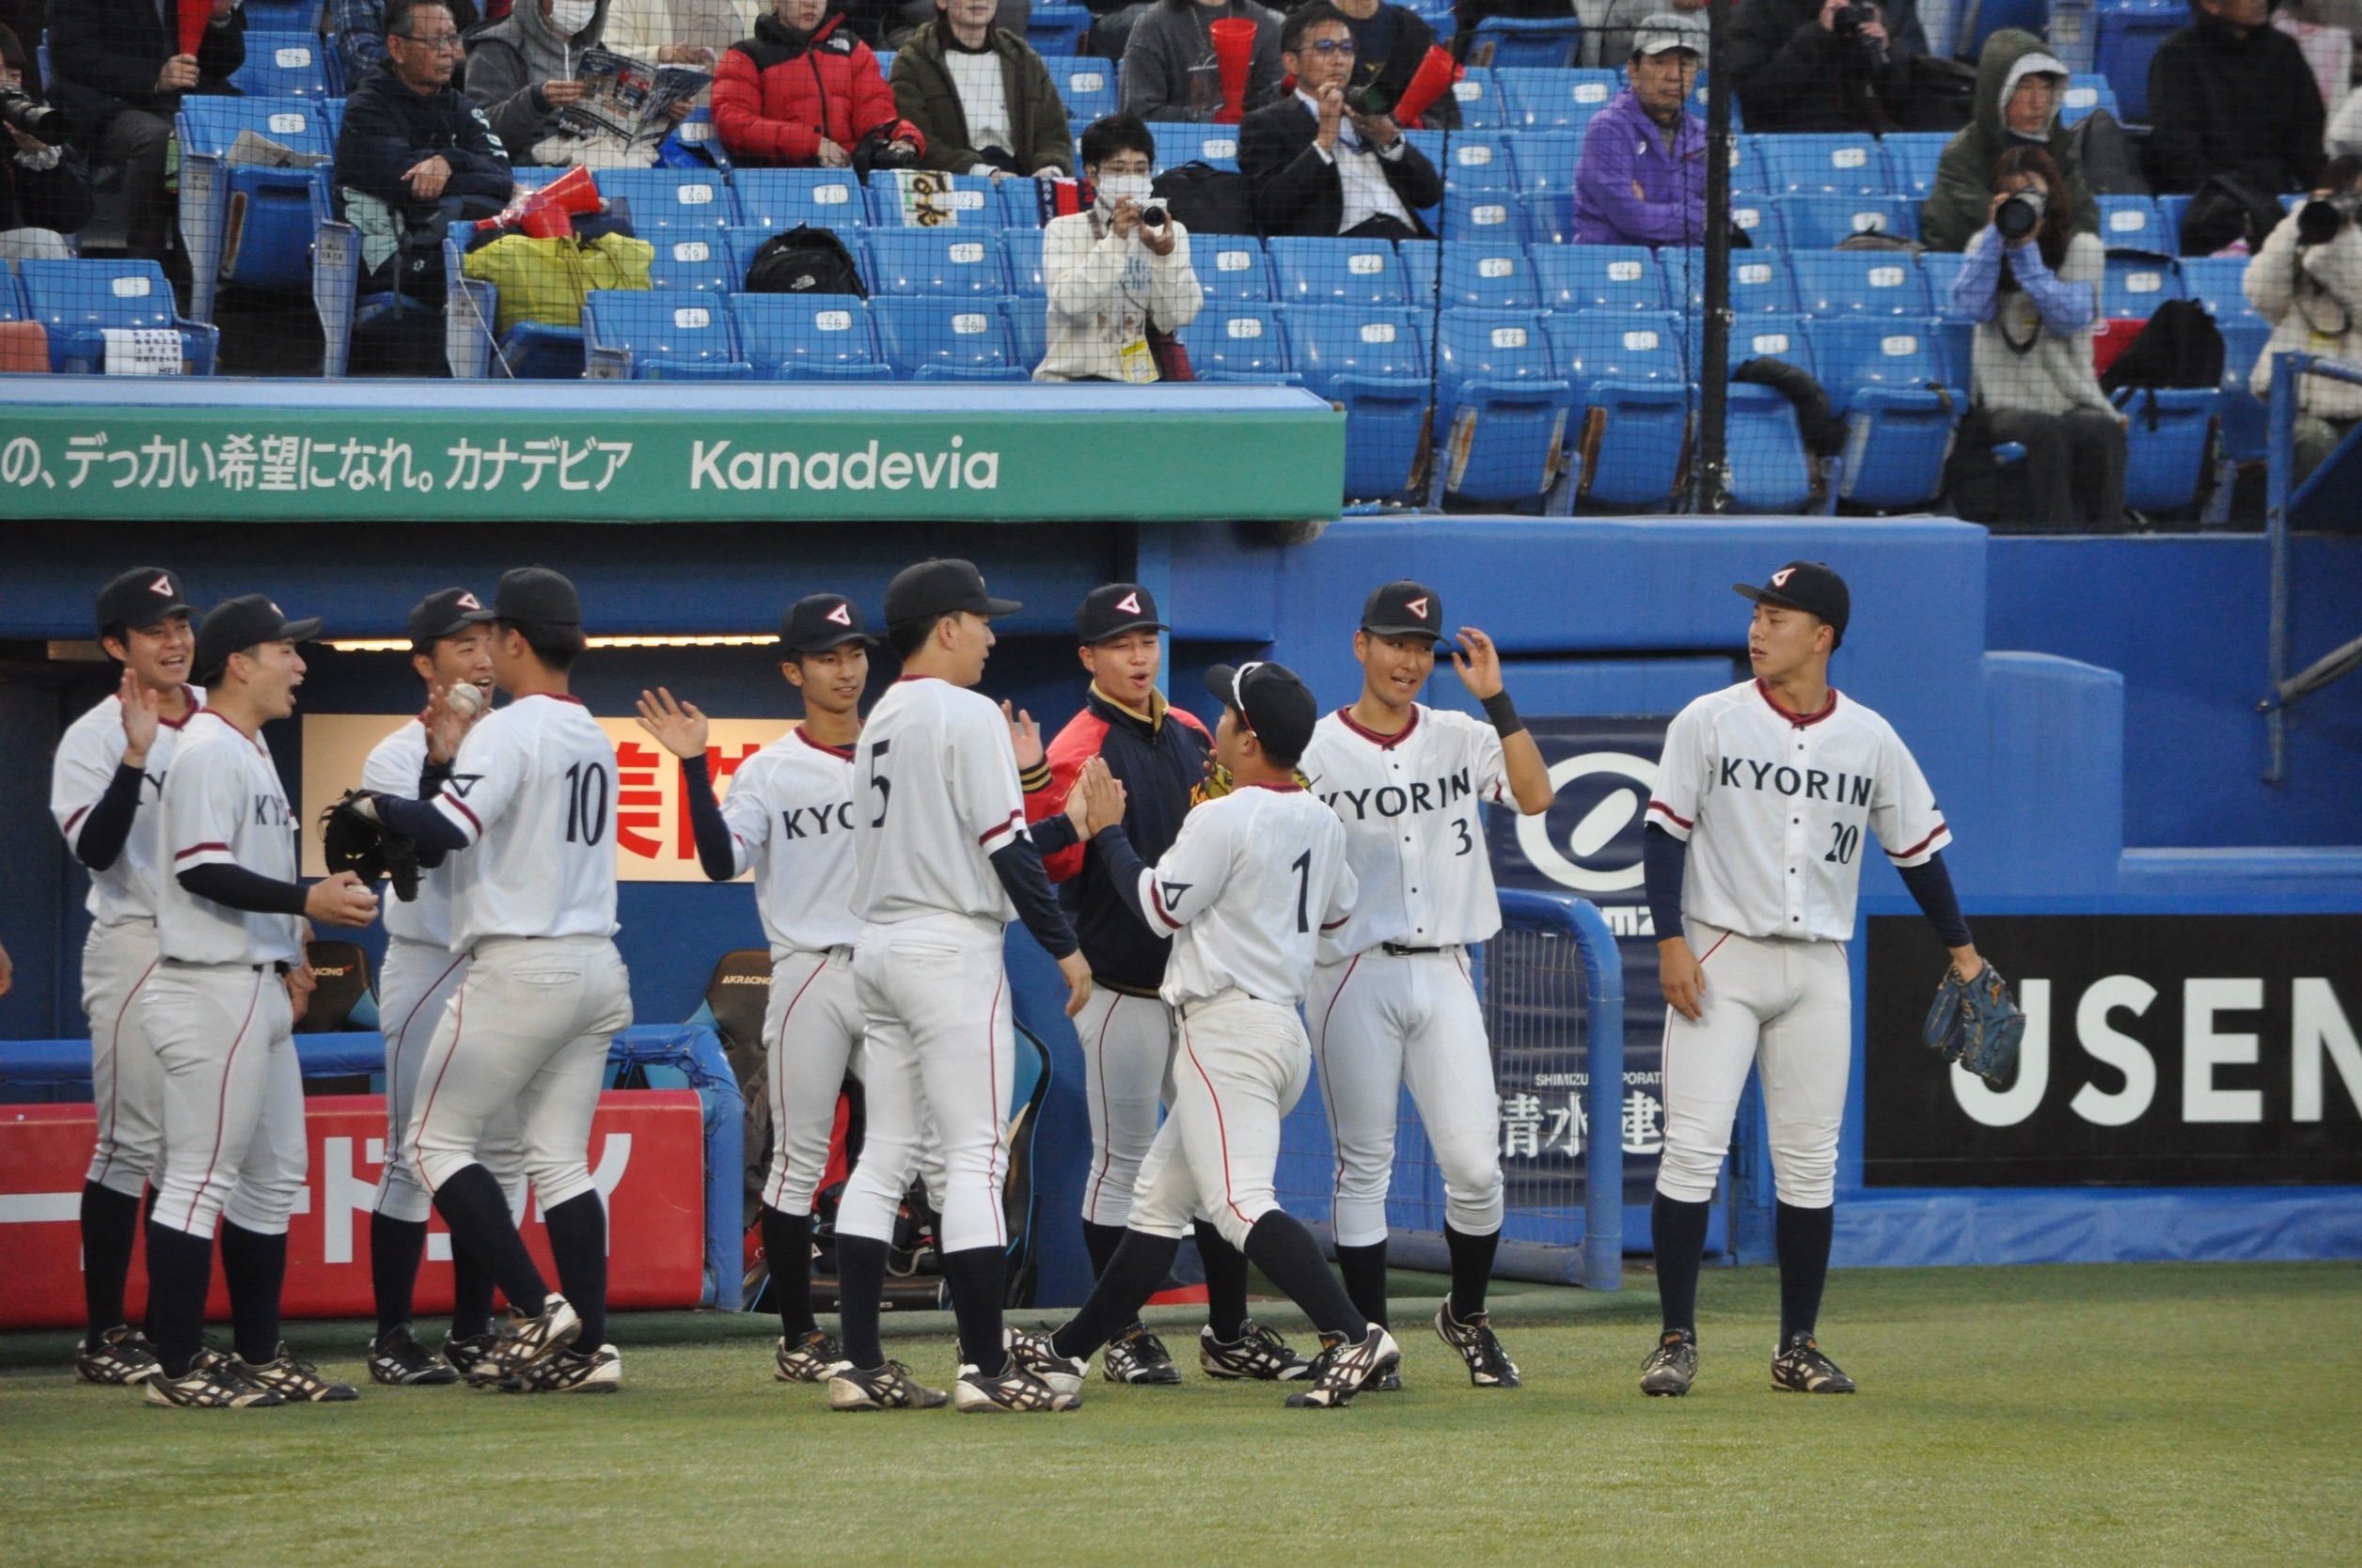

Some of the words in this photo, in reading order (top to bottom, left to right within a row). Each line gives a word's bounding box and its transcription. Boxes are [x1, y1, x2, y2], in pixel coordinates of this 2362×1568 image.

[690, 435, 1000, 490] Kanadevia
[565, 760, 608, 847] 10
[871, 739, 891, 828] 5
[1721, 756, 1873, 807] KYORIN
[782, 801, 855, 839] KYO
[1451, 818, 1472, 856] 3
[1824, 822, 1859, 864] 20
[1292, 848, 1311, 933] 1
[721, 975, 771, 985] AKRACING
[1950, 974, 2362, 1126] USEN
[1535, 1073, 1589, 1086] SHIMIZU
